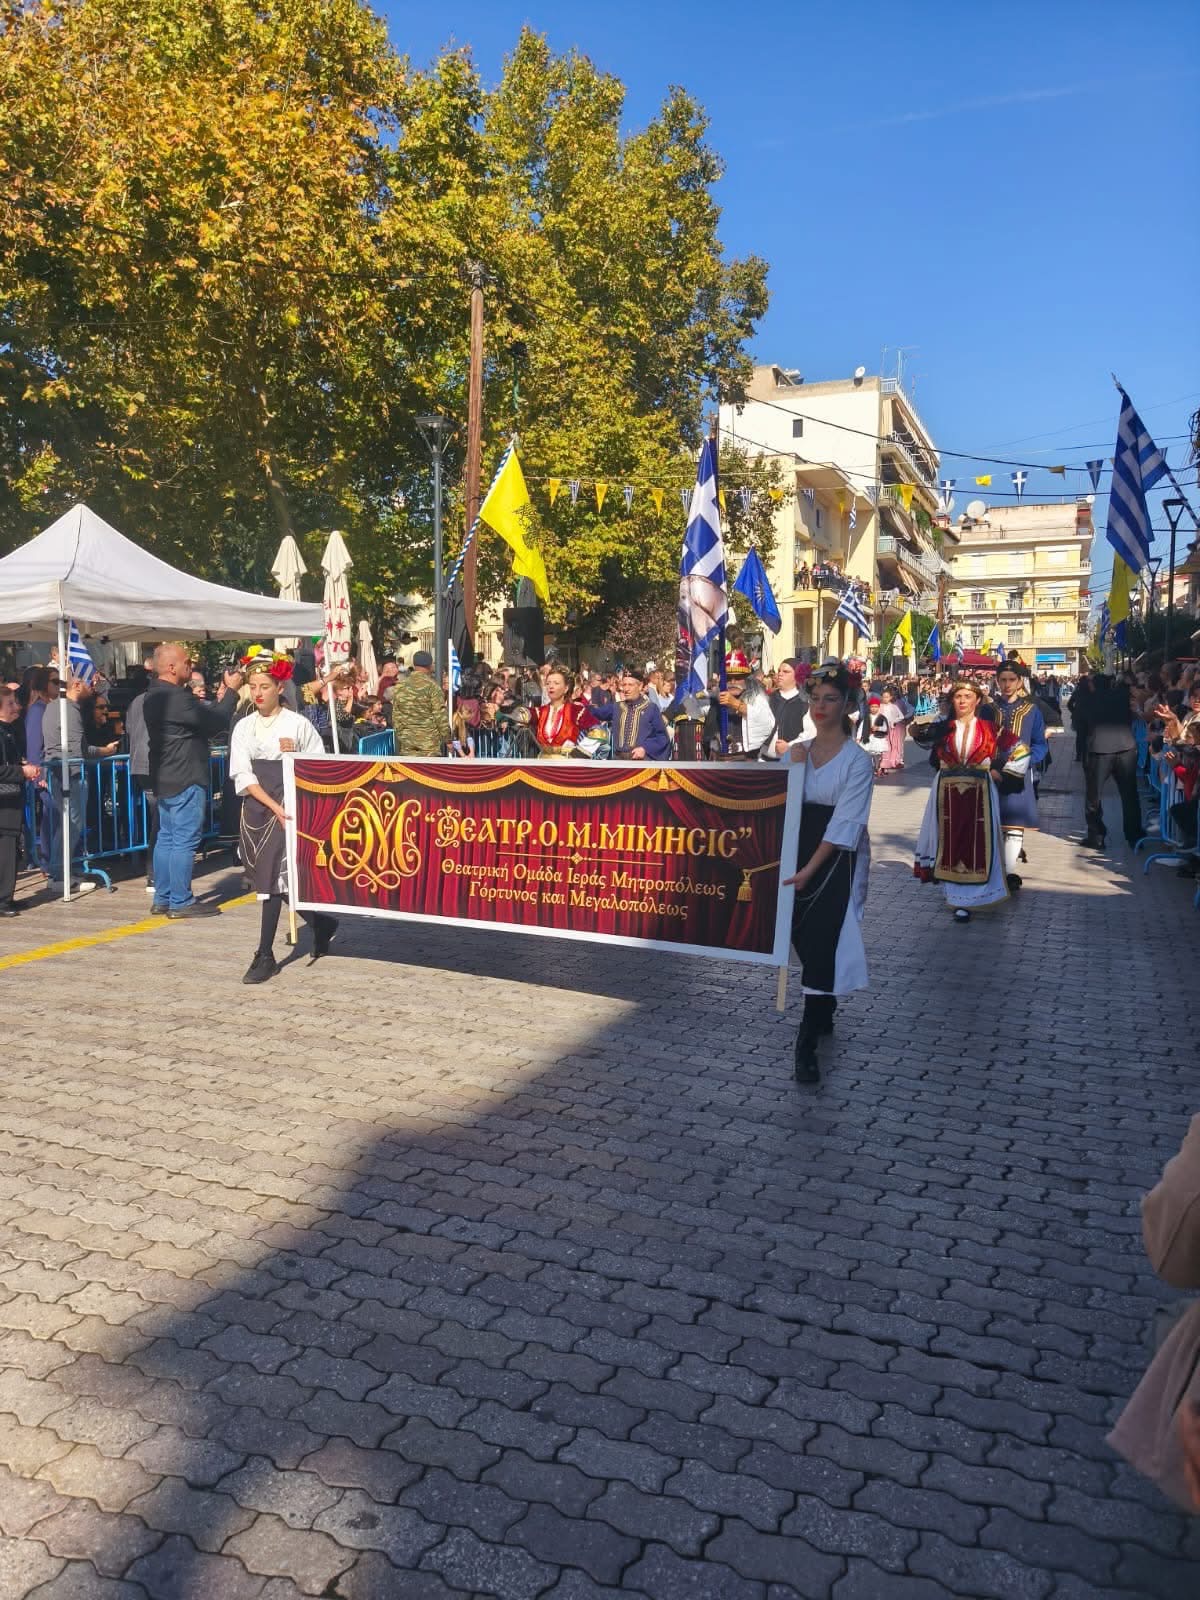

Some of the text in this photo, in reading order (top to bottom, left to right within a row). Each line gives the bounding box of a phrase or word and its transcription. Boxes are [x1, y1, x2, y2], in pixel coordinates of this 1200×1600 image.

[441, 858, 726, 900] Θεατρική Ομάδα Ιεράς Μητροπόλεως
[469, 881, 689, 920] Γόρτυνος και Μεγαλοπόλεως
